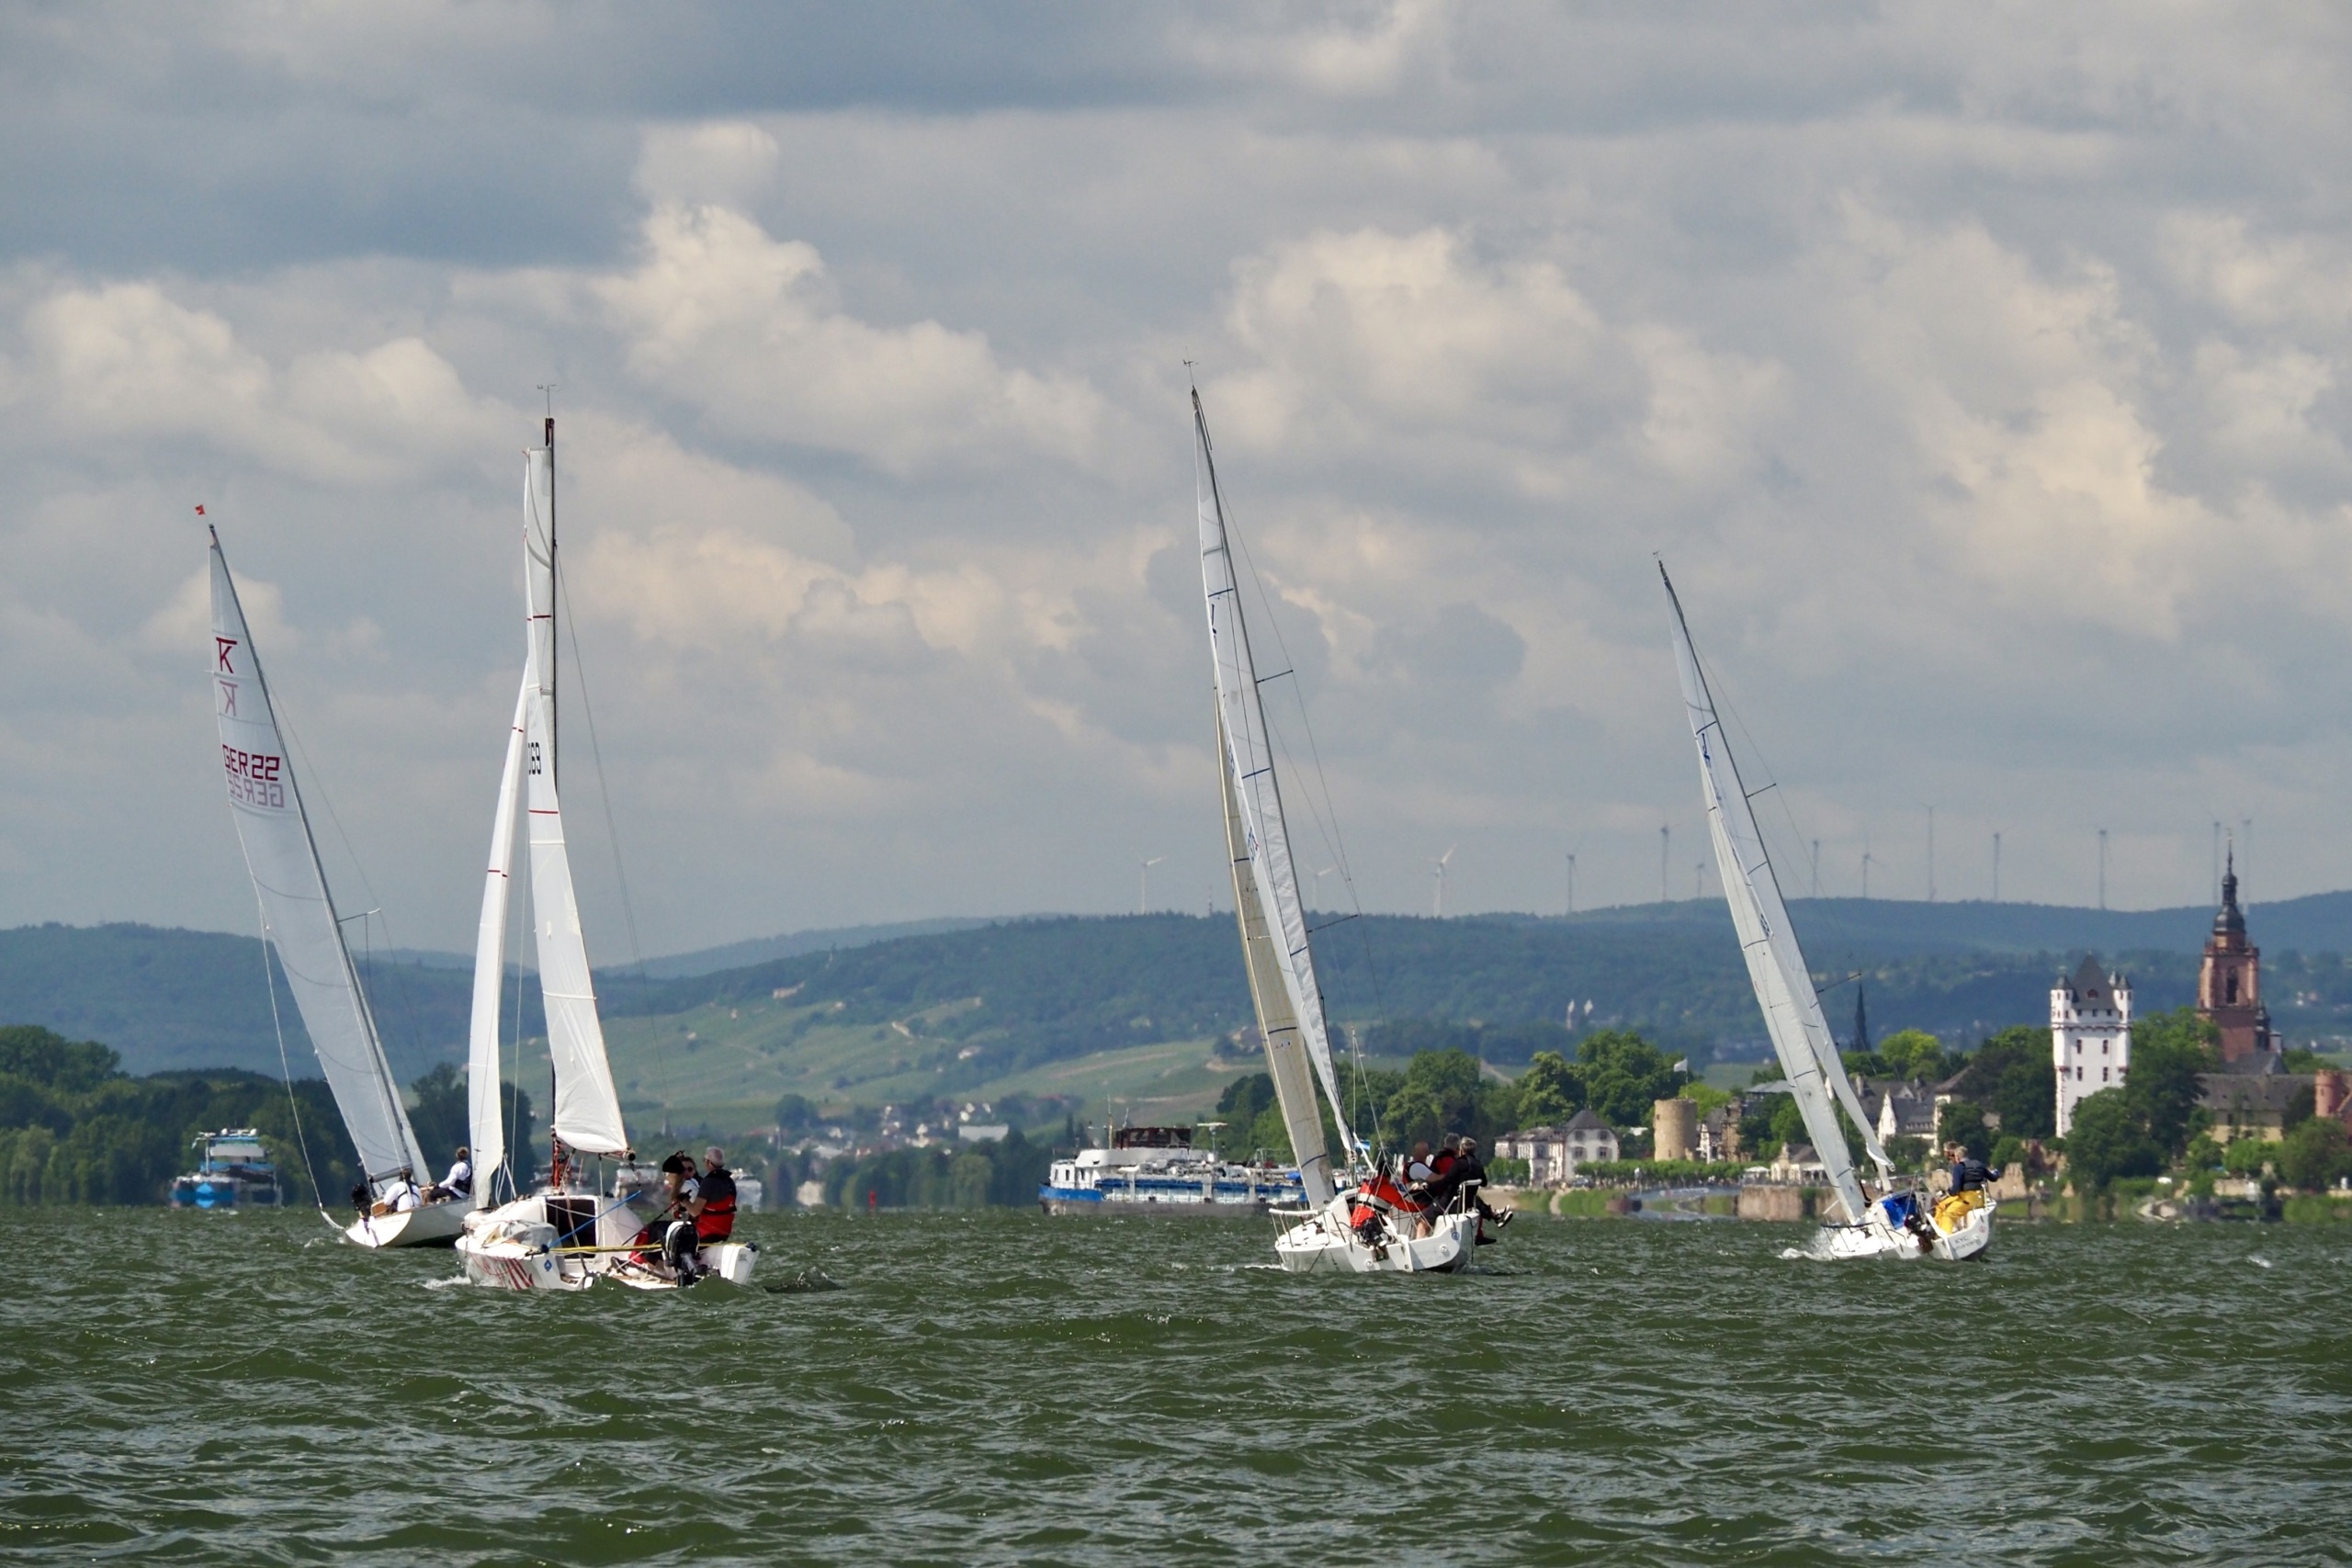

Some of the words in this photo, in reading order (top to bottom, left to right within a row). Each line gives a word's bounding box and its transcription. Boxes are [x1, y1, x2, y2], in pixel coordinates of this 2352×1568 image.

[216, 637, 237, 674] K
[222, 743, 248, 777] GER
[252, 754, 280, 782] 22
